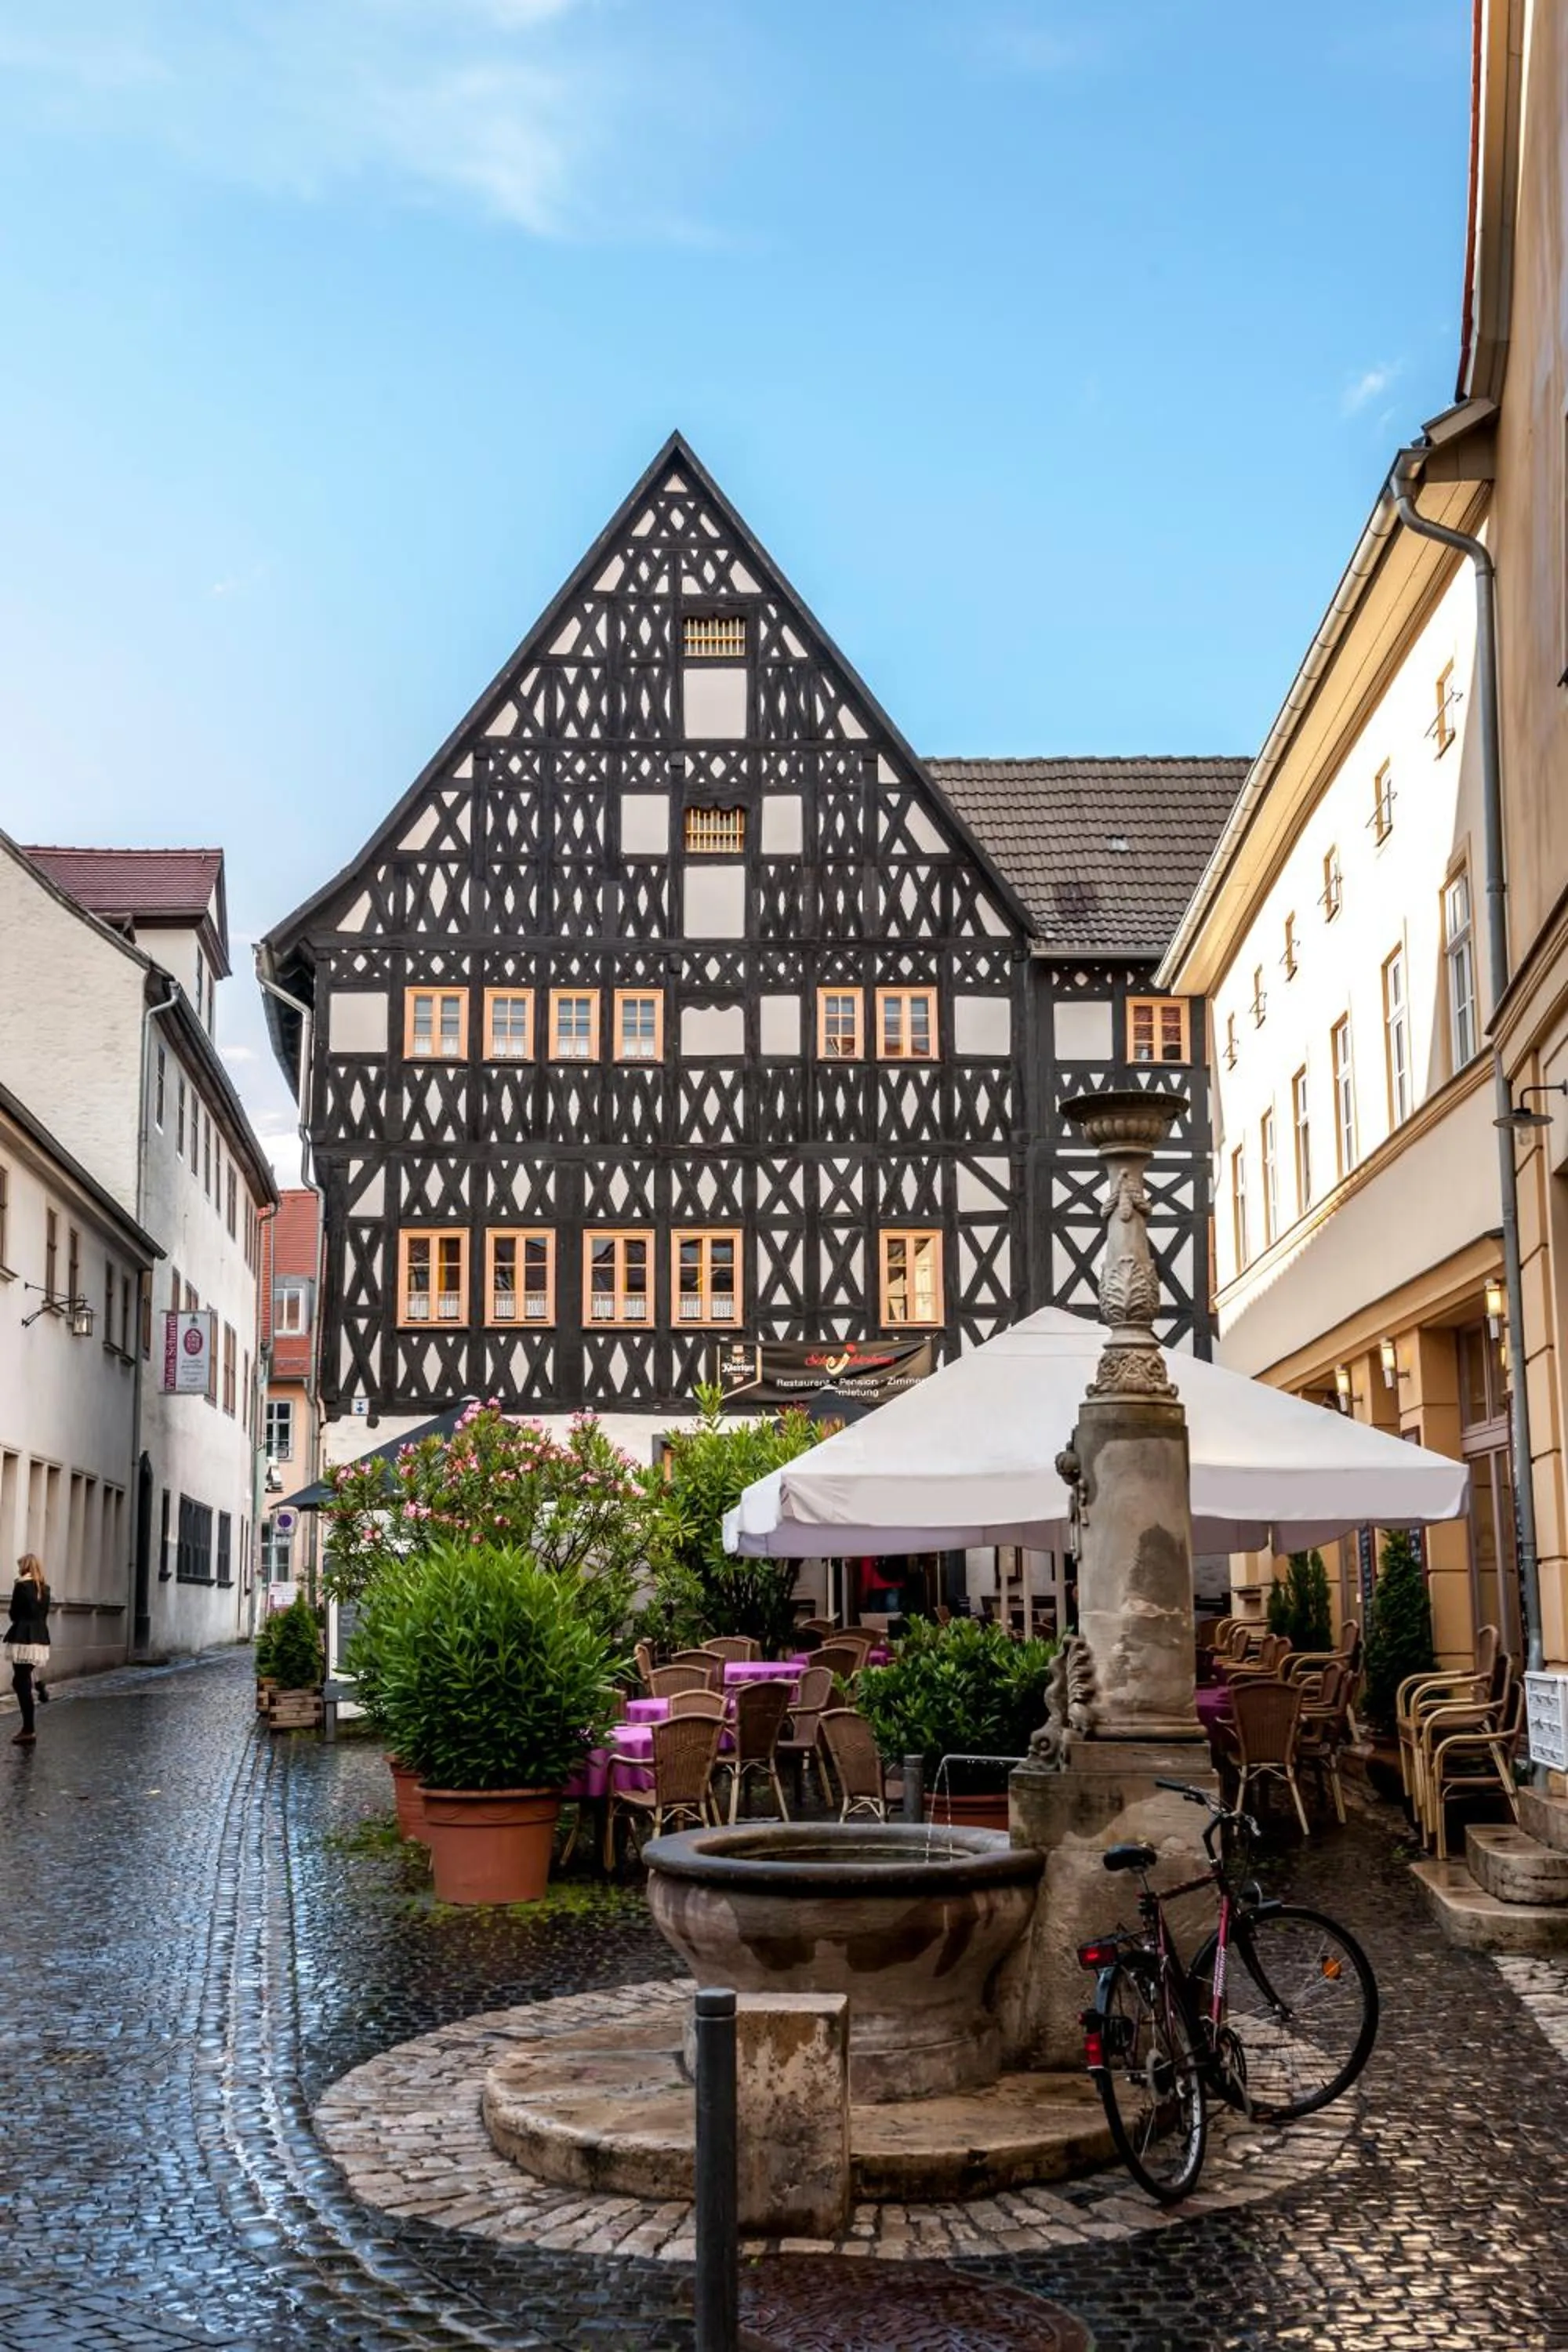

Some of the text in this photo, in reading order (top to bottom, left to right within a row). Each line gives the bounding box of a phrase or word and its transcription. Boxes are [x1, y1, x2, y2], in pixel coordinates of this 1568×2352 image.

[776, 1377, 923, 1387] Restaurant Pension Zimme
